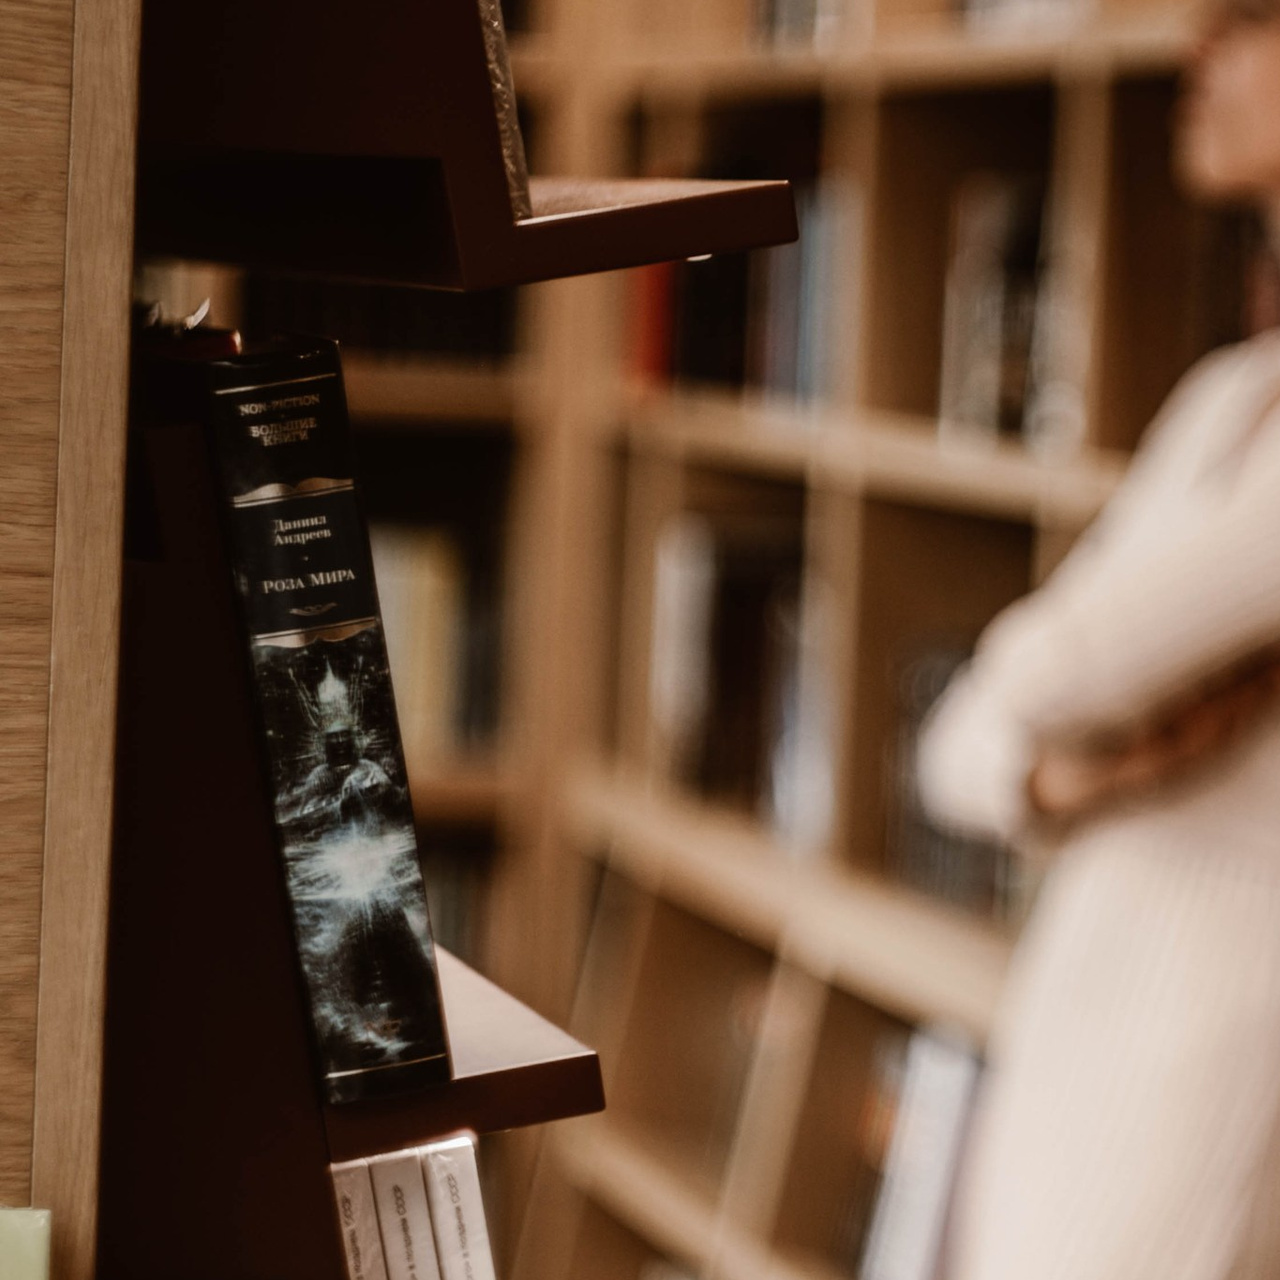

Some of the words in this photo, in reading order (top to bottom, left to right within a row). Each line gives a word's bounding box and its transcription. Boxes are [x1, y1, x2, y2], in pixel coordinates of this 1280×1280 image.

[273, 515, 327, 533] Даниил
[273, 525, 332, 547] Андреев
[262, 577, 306, 595] РОЗА
[310, 568, 355, 588] МИРА
